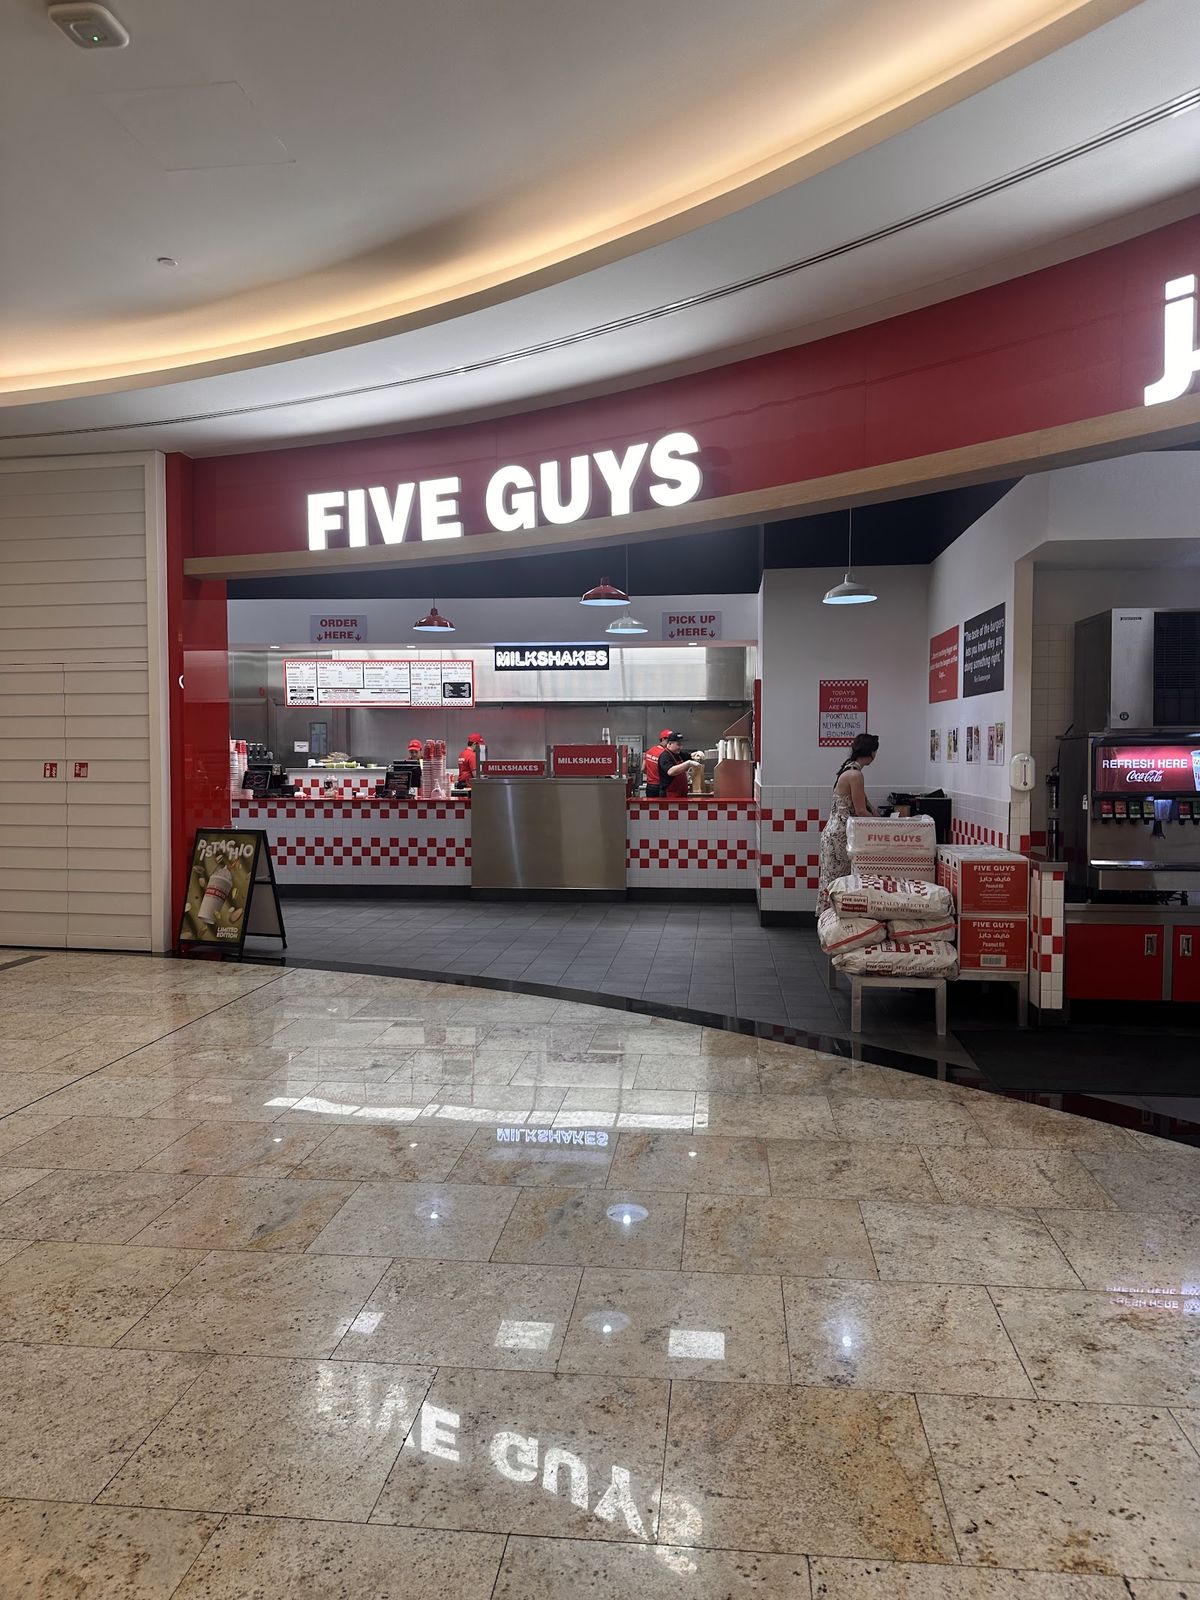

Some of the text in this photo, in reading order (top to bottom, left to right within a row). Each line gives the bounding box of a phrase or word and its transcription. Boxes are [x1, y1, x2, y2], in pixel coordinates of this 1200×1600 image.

[307, 432, 703, 551] FIVE GUYS
[320, 619, 358, 628] ORDER
[669, 615, 716, 624] PICK UP
[324, 631, 354, 639] HERE
[677, 628, 708, 636] HERE
[496, 650, 608, 667] MILKSHAKES
[488, 764, 539, 772] MILKSHAKES
[1102, 759, 1188, 768] REFRESH HERE
[1126, 770, 1165, 782] Coca-Cola
[868, 834, 922, 842] FIVE GUYS
[197, 839, 254, 861] PISTACHIO
